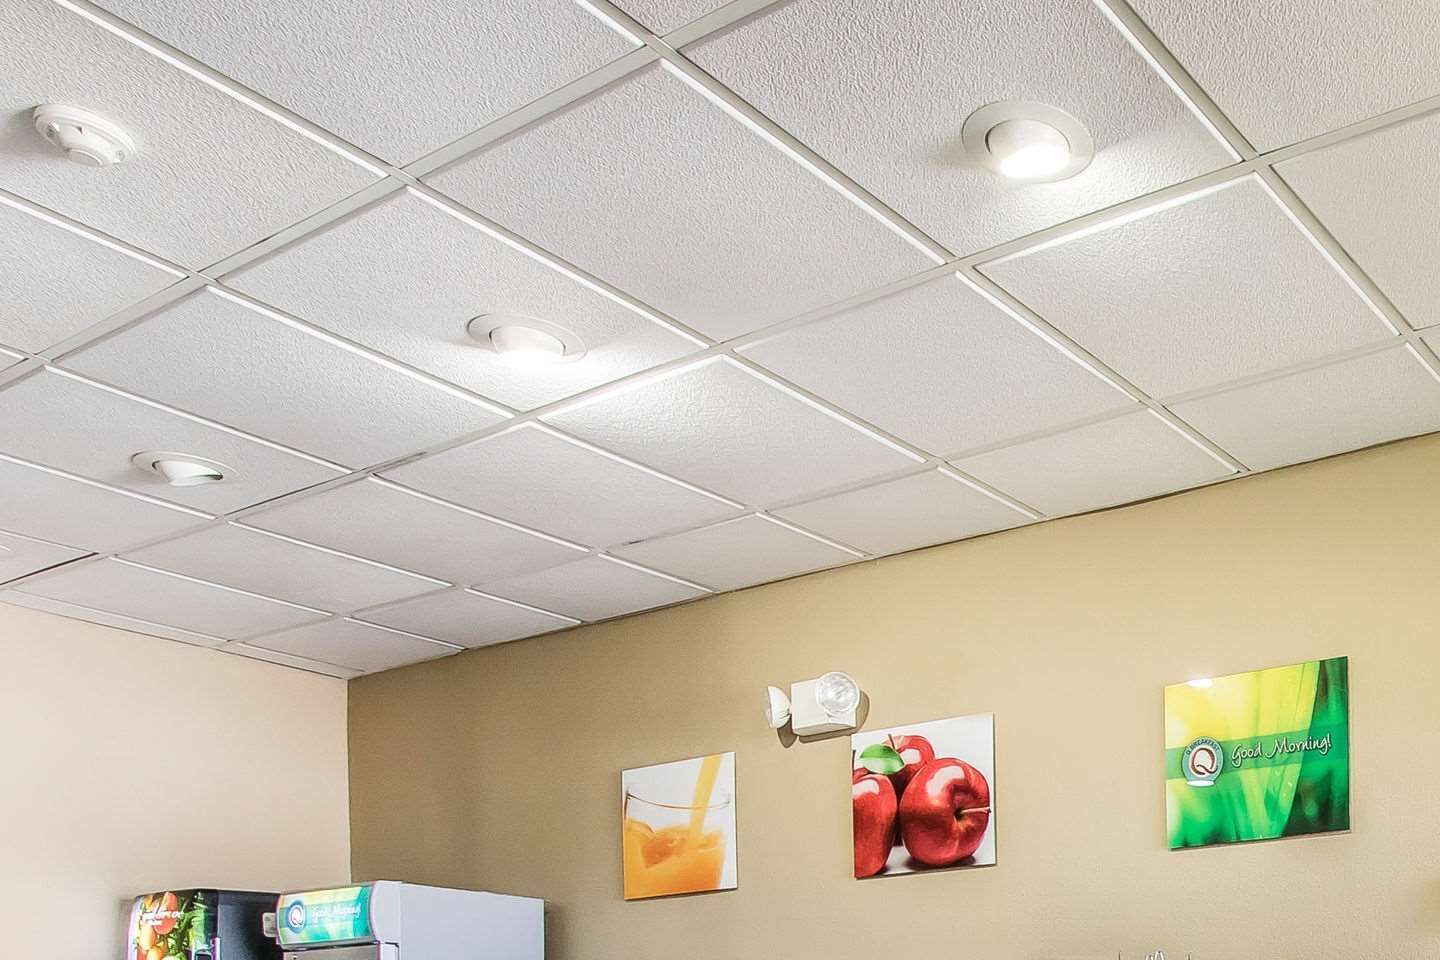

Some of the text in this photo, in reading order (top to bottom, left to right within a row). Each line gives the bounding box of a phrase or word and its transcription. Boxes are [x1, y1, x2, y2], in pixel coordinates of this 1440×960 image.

[1190, 747, 1219, 775] Q
[1231, 733, 1332, 768] Good Morning!
